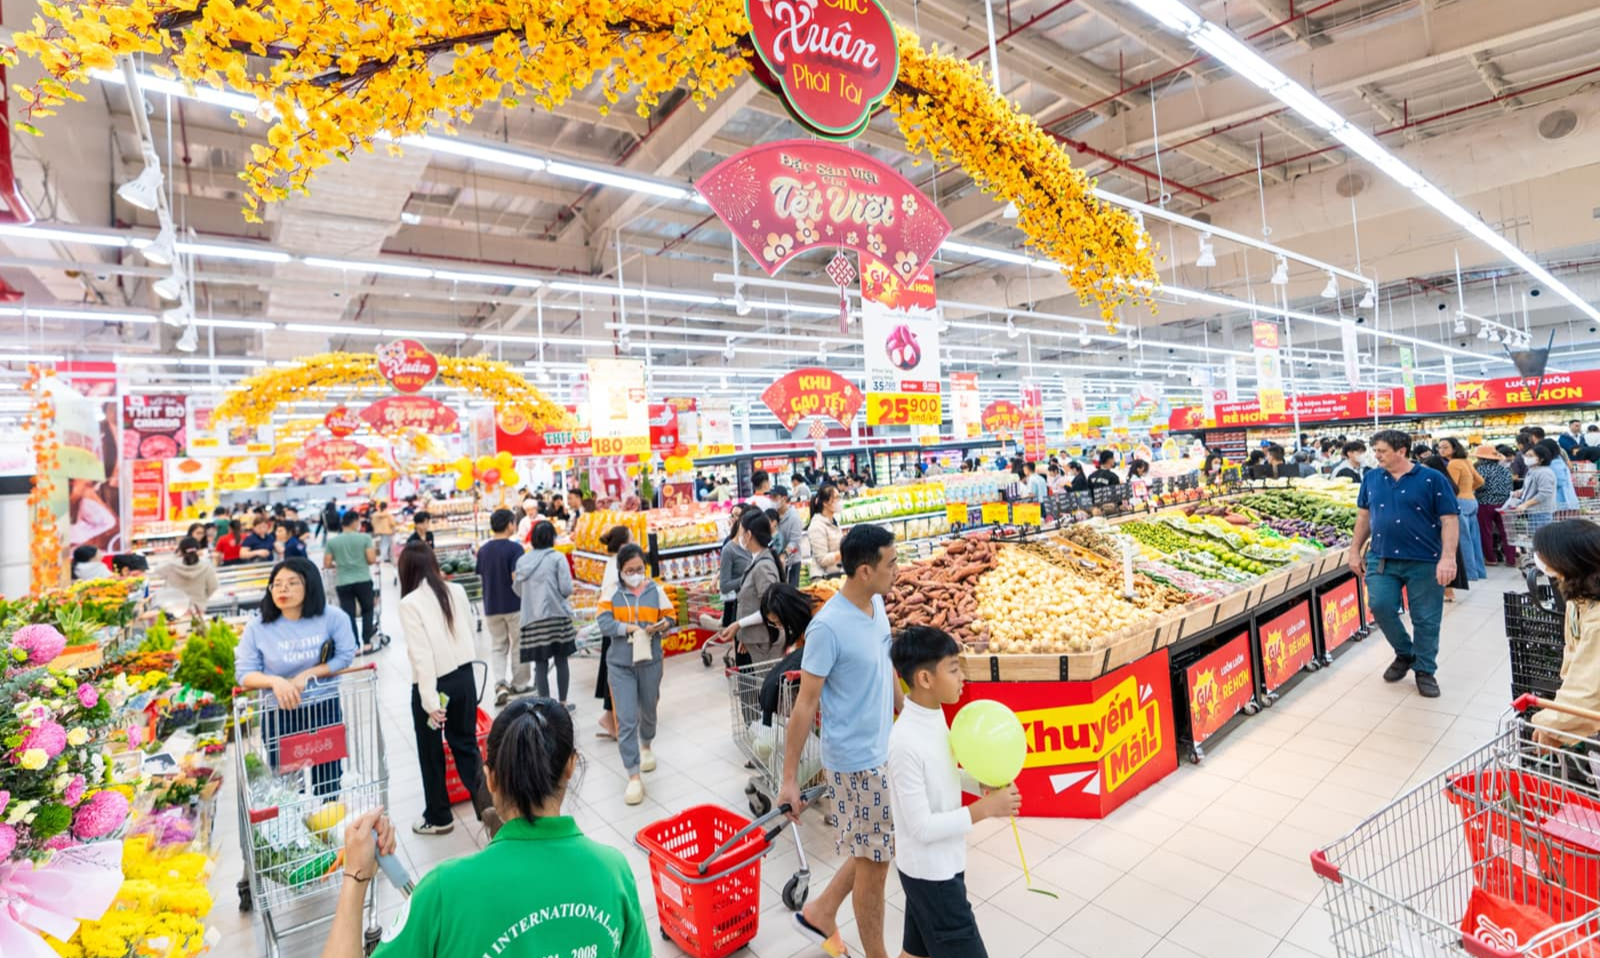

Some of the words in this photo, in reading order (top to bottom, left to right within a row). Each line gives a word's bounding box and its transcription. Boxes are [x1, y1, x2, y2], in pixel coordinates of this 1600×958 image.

[774, 1, 878, 68] Xuân
[770, 176, 823, 222] Tết
[826, 186, 895, 232] Việt
[799, 375, 831, 391] KHU
[873, 381, 884, 391] 35
[1541, 375, 1571, 386] UÔN
[1506, 386, 1532, 403] RẺ
[1536, 386, 1583, 401] HƠN
[879, 398, 908, 424] 25
[910, 398, 937, 412] 900
[594, 438, 623, 453] 180
[1222, 674, 1234, 699] RẺ
[1233, 668, 1249, 694] HƠN
[1109, 704, 1158, 786] Mãi!
